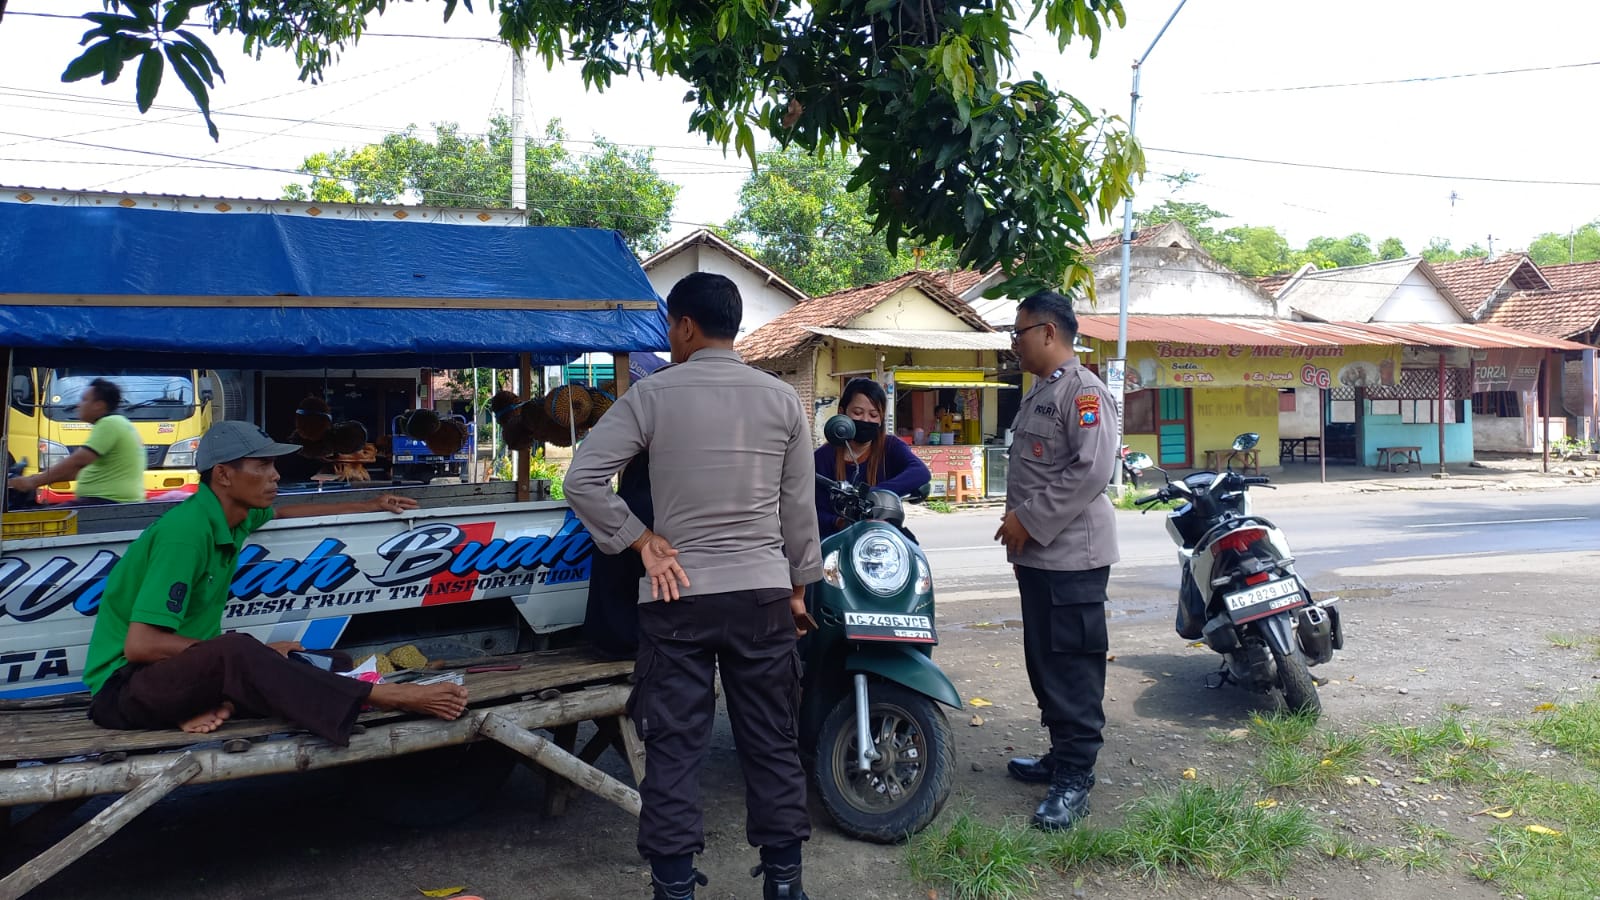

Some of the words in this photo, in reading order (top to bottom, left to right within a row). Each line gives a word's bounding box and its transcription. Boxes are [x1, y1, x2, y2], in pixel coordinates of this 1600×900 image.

[1158, 344, 1220, 358] Bakso
[1228, 344, 1243, 358] &
[1251, 345, 1284, 358] Mie
[1301, 363, 1331, 389] GG
[1474, 365, 1506, 379] FORZA
[1034, 404, 1056, 417] POLRI
[363, 517, 593, 587] Buah
[166, 581, 188, 614] 9
[223, 597, 297, 618] RESH
[302, 589, 381, 610] FRUIT
[389, 567, 585, 600] TRANSPORTATION
[1230, 597, 1246, 609] AG
[1248, 586, 1278, 603] 2829
[1280, 581, 1296, 594] UY
[848, 614, 864, 625] AG
[868, 615, 899, 627] 2496
[903, 616, 929, 628] VCE
